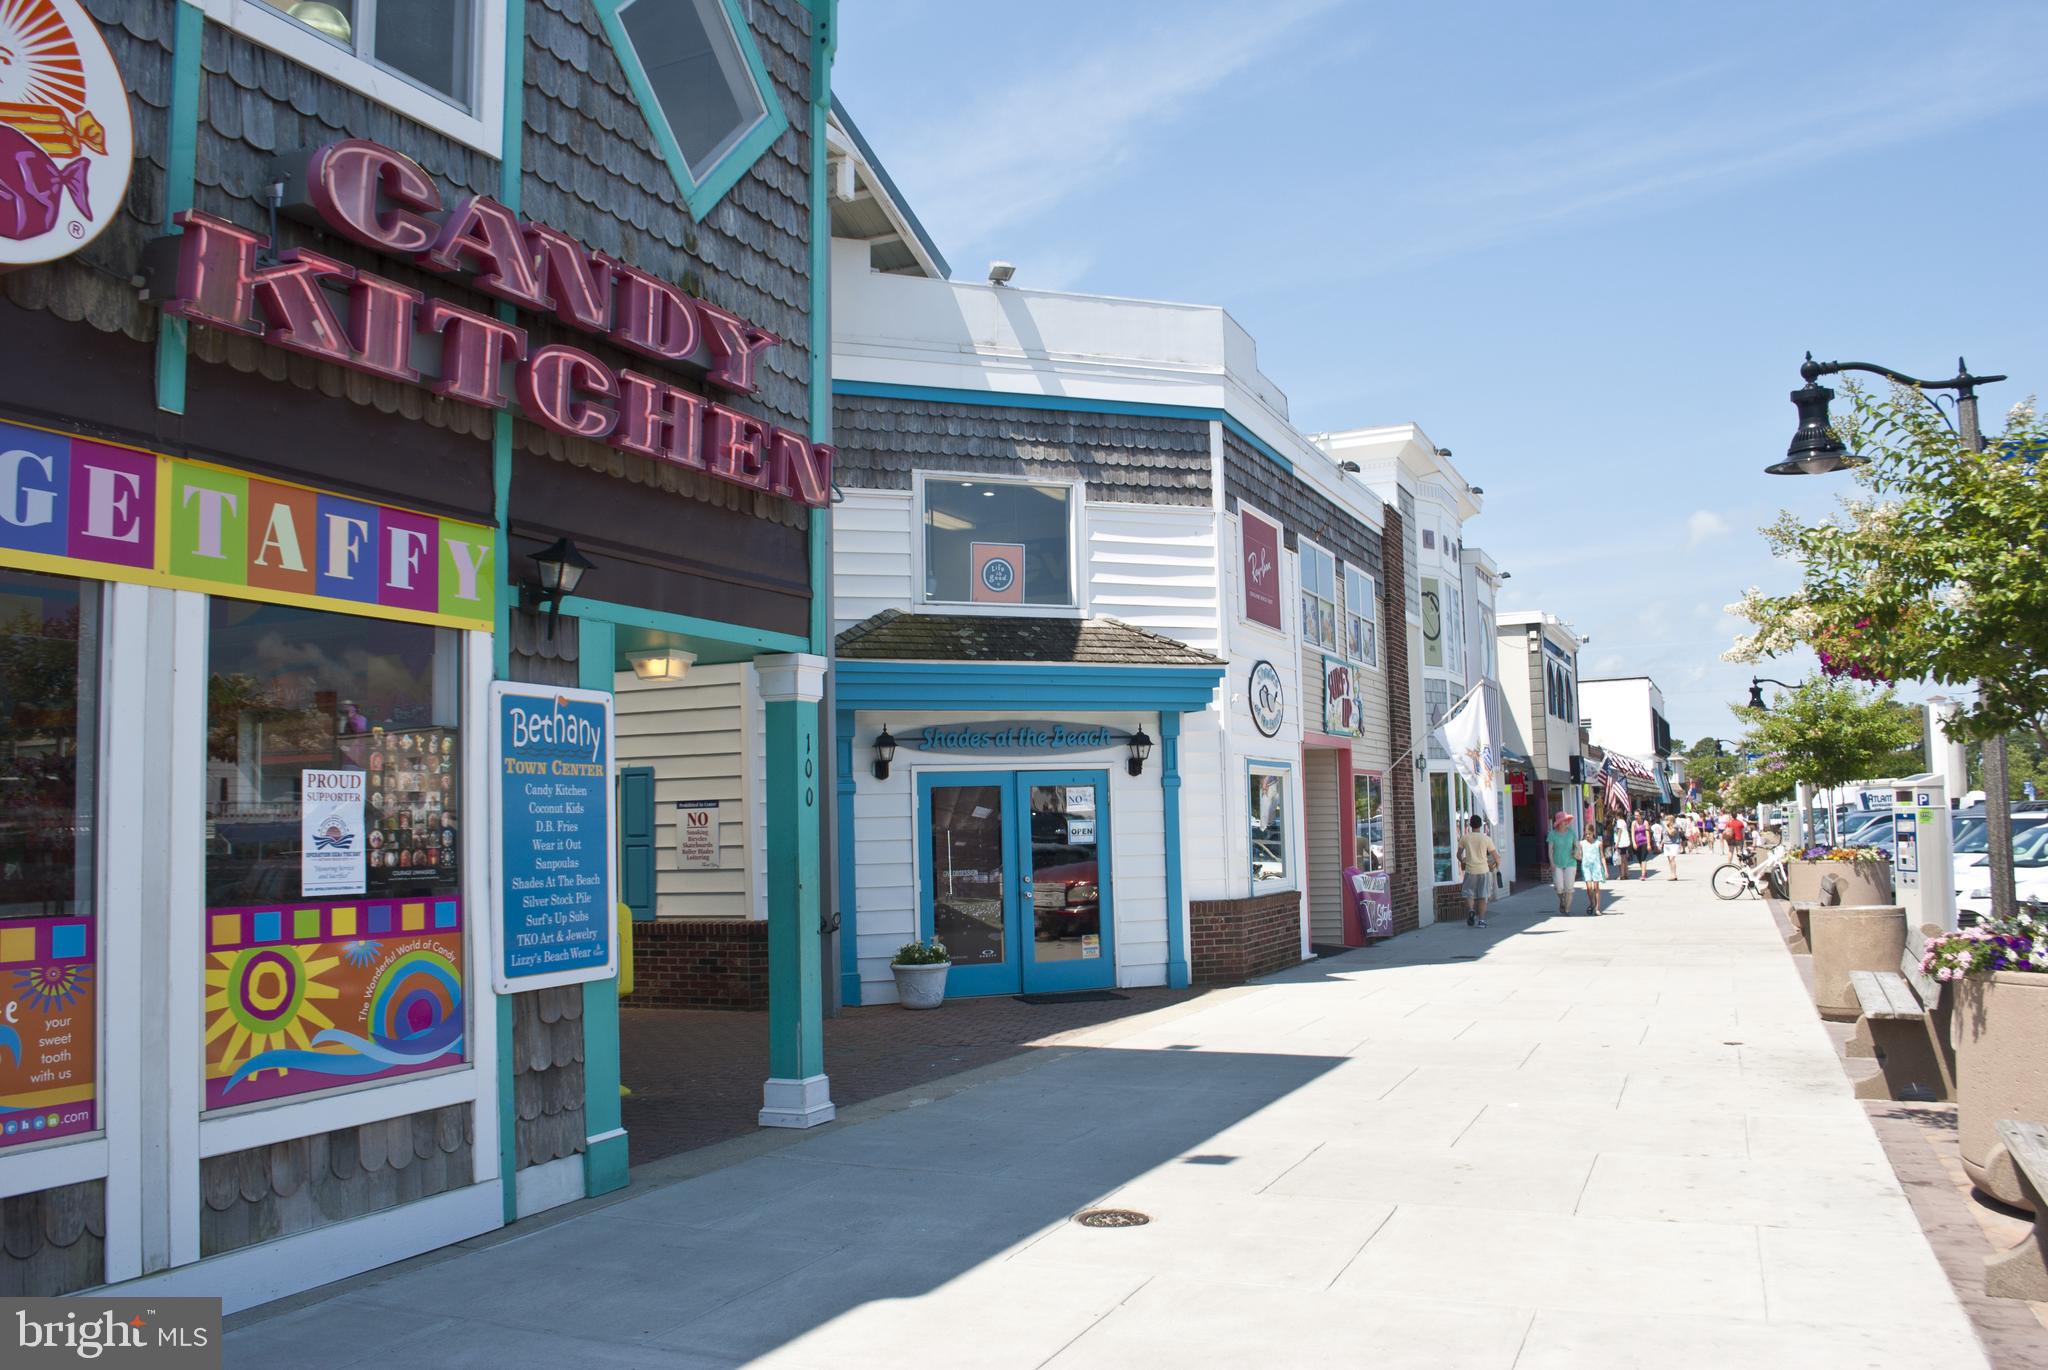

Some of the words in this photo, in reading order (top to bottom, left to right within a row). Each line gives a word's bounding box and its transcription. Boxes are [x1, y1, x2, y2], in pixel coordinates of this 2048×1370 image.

[308, 138, 782, 394] CANDY
[164, 208, 837, 509] KITCHEN
[183, 484, 490, 601] TAFFY
[509, 694, 601, 763] Bethany
[918, 727, 991, 750] Shades
[994, 727, 1013, 748] at
[1017, 726, 1048, 748] the
[1051, 724, 1111, 748] Beach
[504, 758, 547, 775] TOWN
[551, 760, 604, 777] CENTER
[805, 733, 813, 807] 100
[307, 773, 362, 789] PROUD
[307, 791, 361, 802] SUPPORTER
[525, 783, 553, 797] Candy
[555, 784, 587, 796] Kitchen
[528, 802, 563, 814] Coconut
[565, 802, 585, 814] Kids
[1919, 795, 1928, 805] P
[536, 821, 555, 832] D.B.
[557, 821, 578, 832] Fries
[687, 812, 709, 826] NO
[532, 839, 556, 851] Wear
[557, 840, 564, 850] it
[566, 838, 582, 850] Out
[535, 857, 580, 871] Sanpoulas
[512, 876, 544, 889] Shades
[545, 876, 556, 888] At
[557, 875, 574, 887] The
[576, 873, 601, 886] Beach
[522, 895, 549, 908] Silver
[551, 893, 574, 906] Stock
[576, 892, 591, 904] Pile
[526, 914, 552, 927] Surf's
[555, 911, 567, 925] Up
[569, 910, 590, 922] Subs
[422, 939, 433, 950] of
[517, 932, 539, 946] TKO
[540, 931, 554, 944] Art
[557, 930, 564, 942] &
[566, 928, 598, 941] Jewelry
[396, 939, 421, 956] World
[432, 942, 456, 963] Candy
[511, 953, 542, 967] Lizzy's
[544, 949, 569, 963] Beach
[570, 946, 591, 958] Wear
[364, 952, 397, 998] Wonderful
[359, 1003, 370, 1022] The
[45, 1016, 72, 1031] your
[39, 1034, 72, 1048] sweet
[41, 1049, 71, 1064] tooth
[30, 1068, 54, 1083] with
[58, 1069, 72, 1080] us
